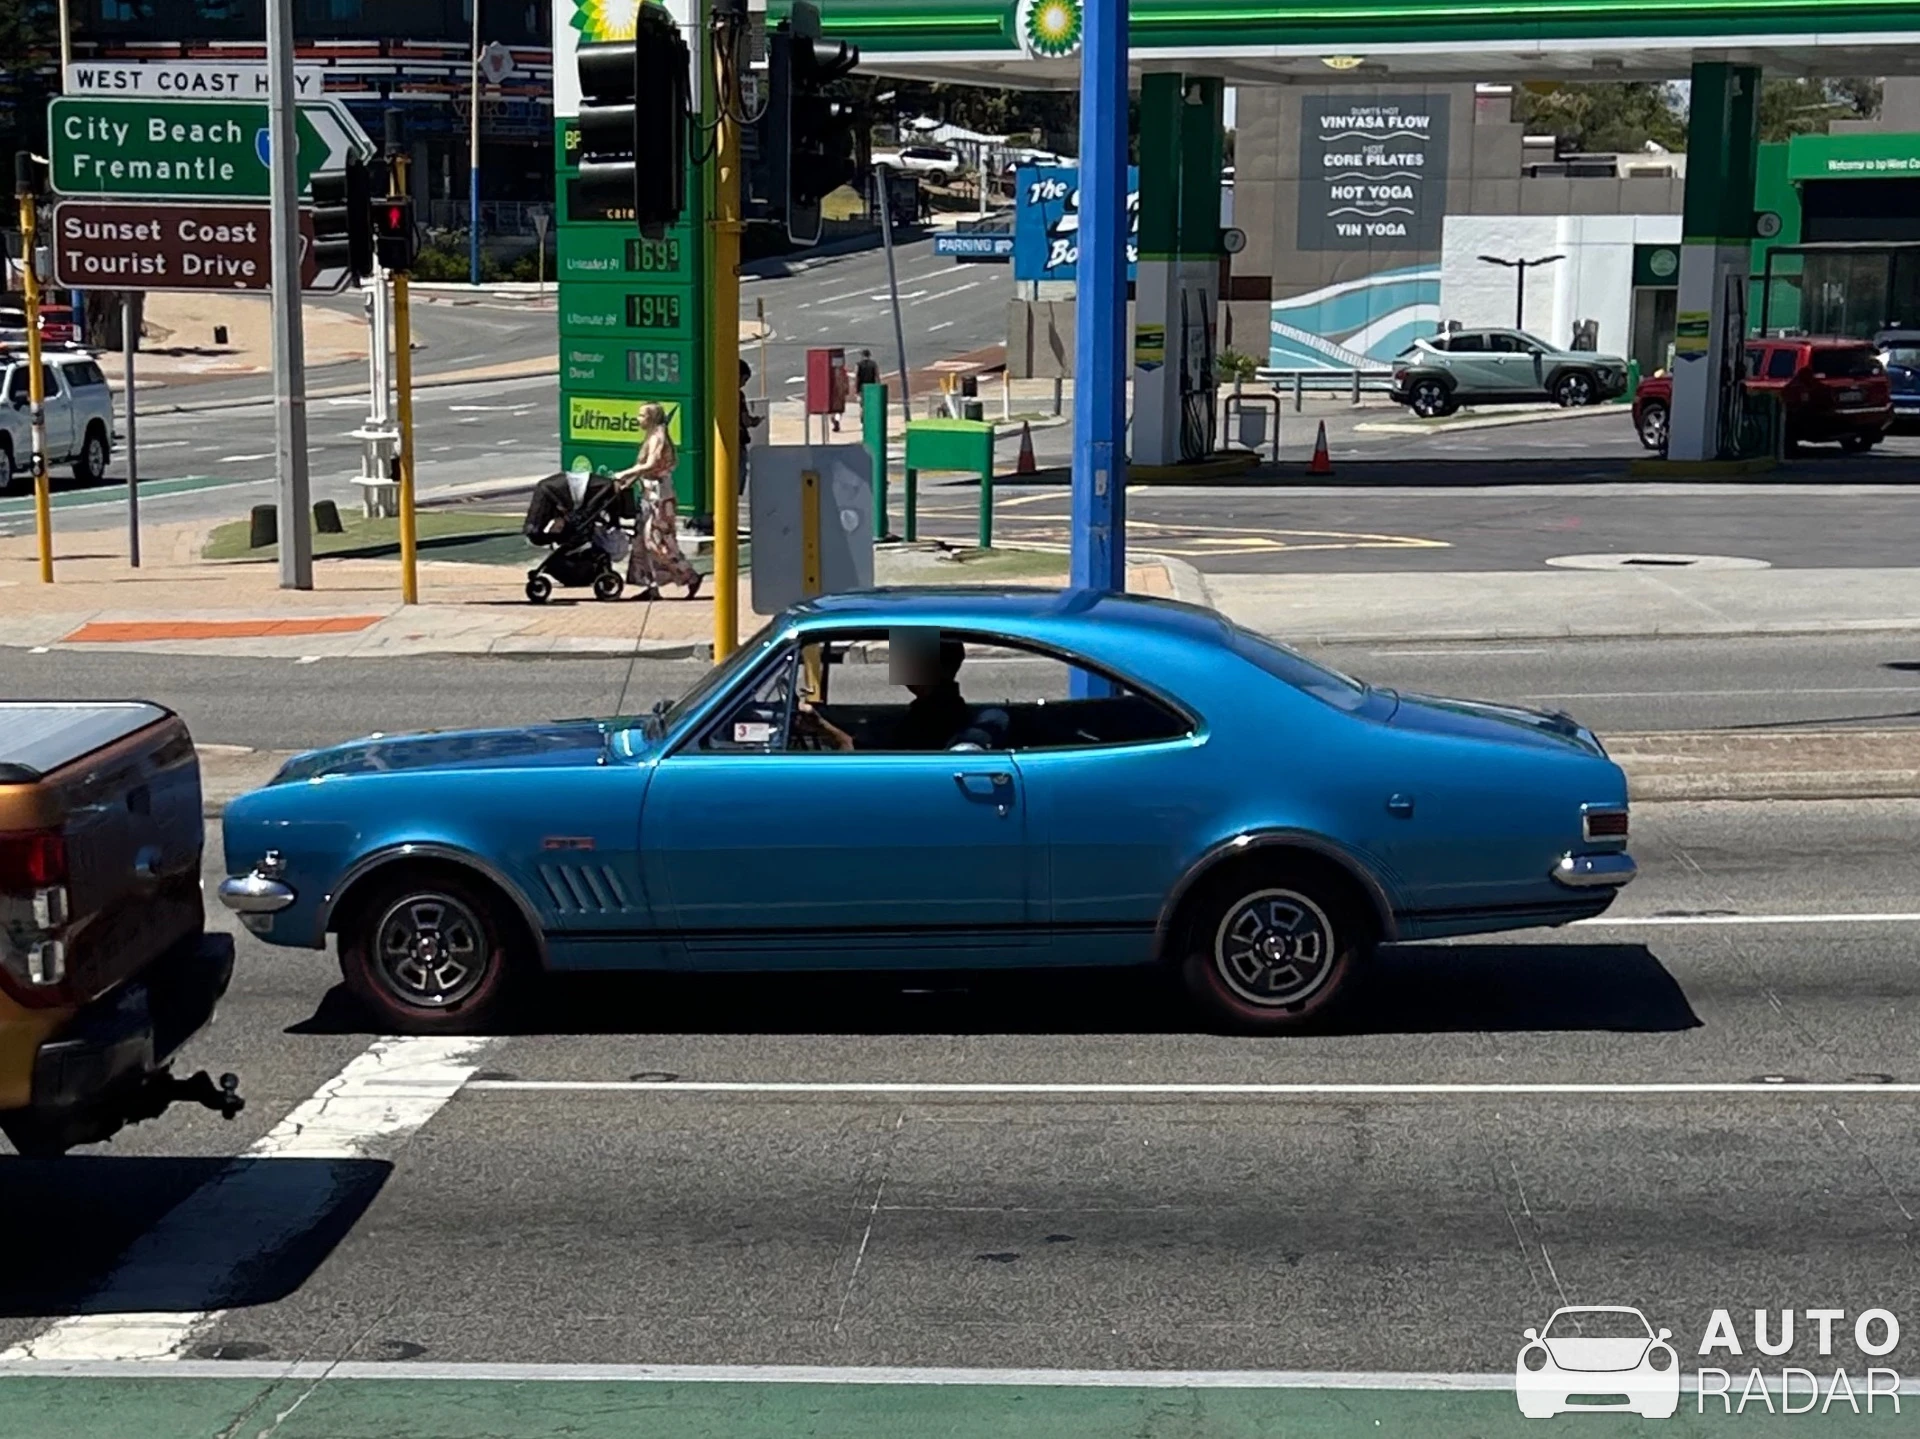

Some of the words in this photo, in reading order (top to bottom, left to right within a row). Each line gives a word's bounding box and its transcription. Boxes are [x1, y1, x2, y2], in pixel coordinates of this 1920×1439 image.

[77, 69, 143, 89] WEST
[157, 72, 240, 92] COAST
[255, 73, 311, 94] HY
[64, 116, 129, 146] City
[149, 117, 242, 143] Beach
[1320, 116, 1385, 128] VINYASA
[1388, 116, 1430, 128] FLOW
[1323, 154, 1363, 167] CORE
[1366, 153, 1424, 167] PILATES
[1362, 145, 1385, 154] HOT
[72, 154, 235, 180] Fremantle
[1029, 178, 1068, 204] The
[1331, 185, 1365, 199] HOT
[1368, 185, 1413, 199] YOGA
[64, 217, 161, 241] Sunset
[178, 220, 257, 243] Coast
[1336, 224, 1362, 236] YIN
[1365, 223, 1406, 236] YOGA
[938, 239, 992, 252] PARKING
[66, 251, 166, 275] Tourist
[182, 253, 257, 276] Drive
[572, 409, 640, 432] ultimate
